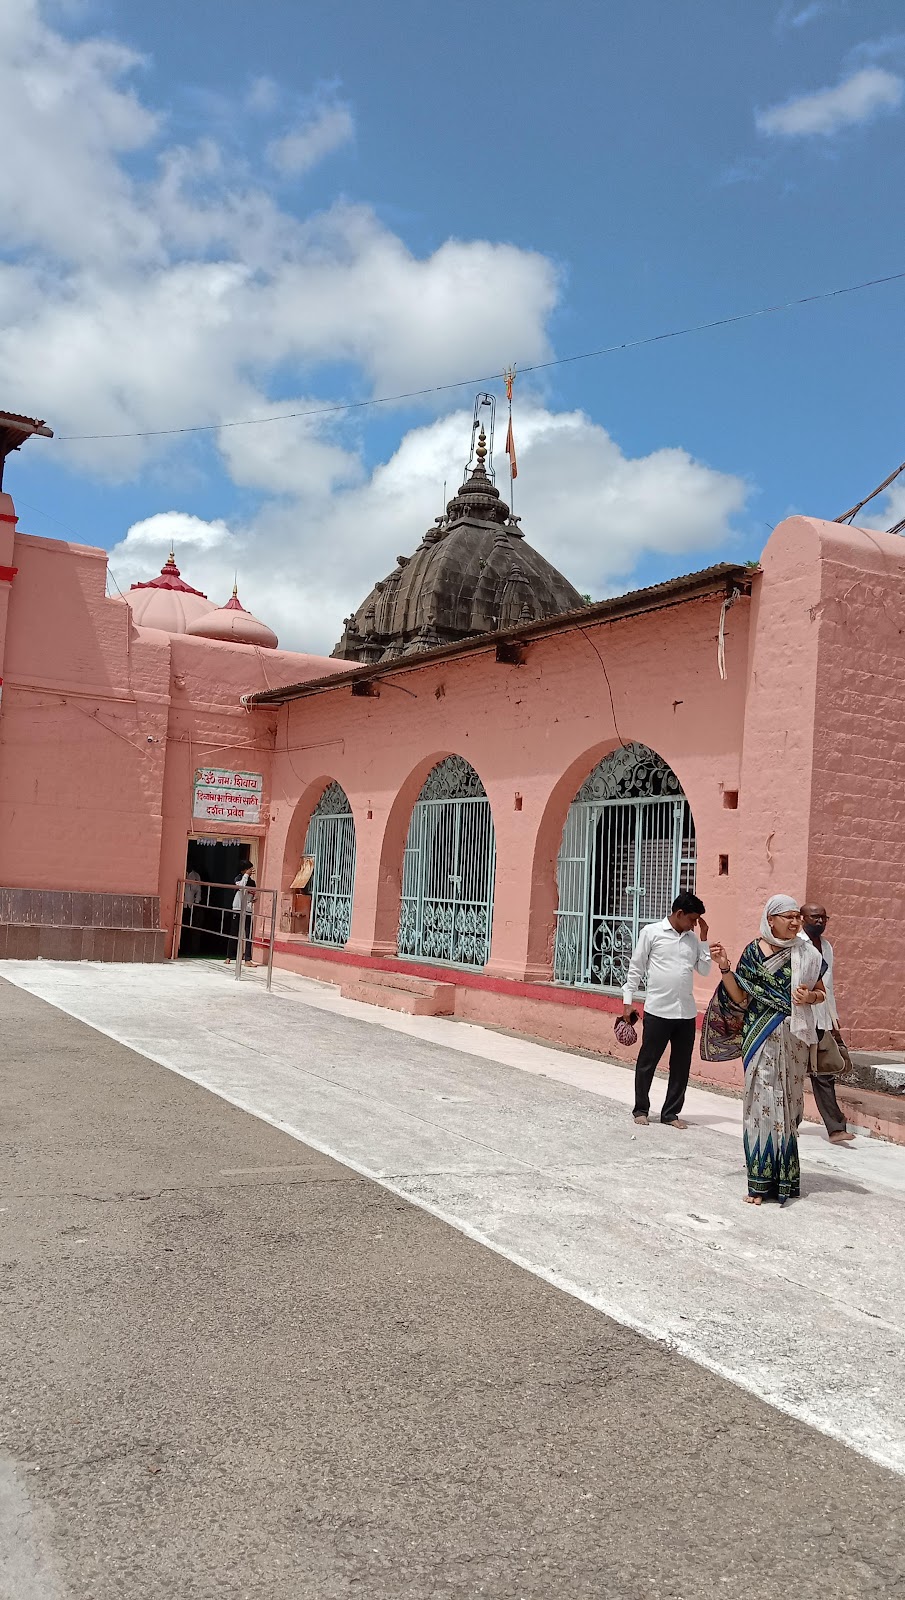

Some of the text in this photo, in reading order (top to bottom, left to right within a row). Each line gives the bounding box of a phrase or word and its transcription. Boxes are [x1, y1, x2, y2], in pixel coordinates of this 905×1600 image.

[203, 771, 215, 784] ॐ
[234, 775, 257, 788] शिवाय
[206, 805, 244, 818] दर्शन प्रवेश
